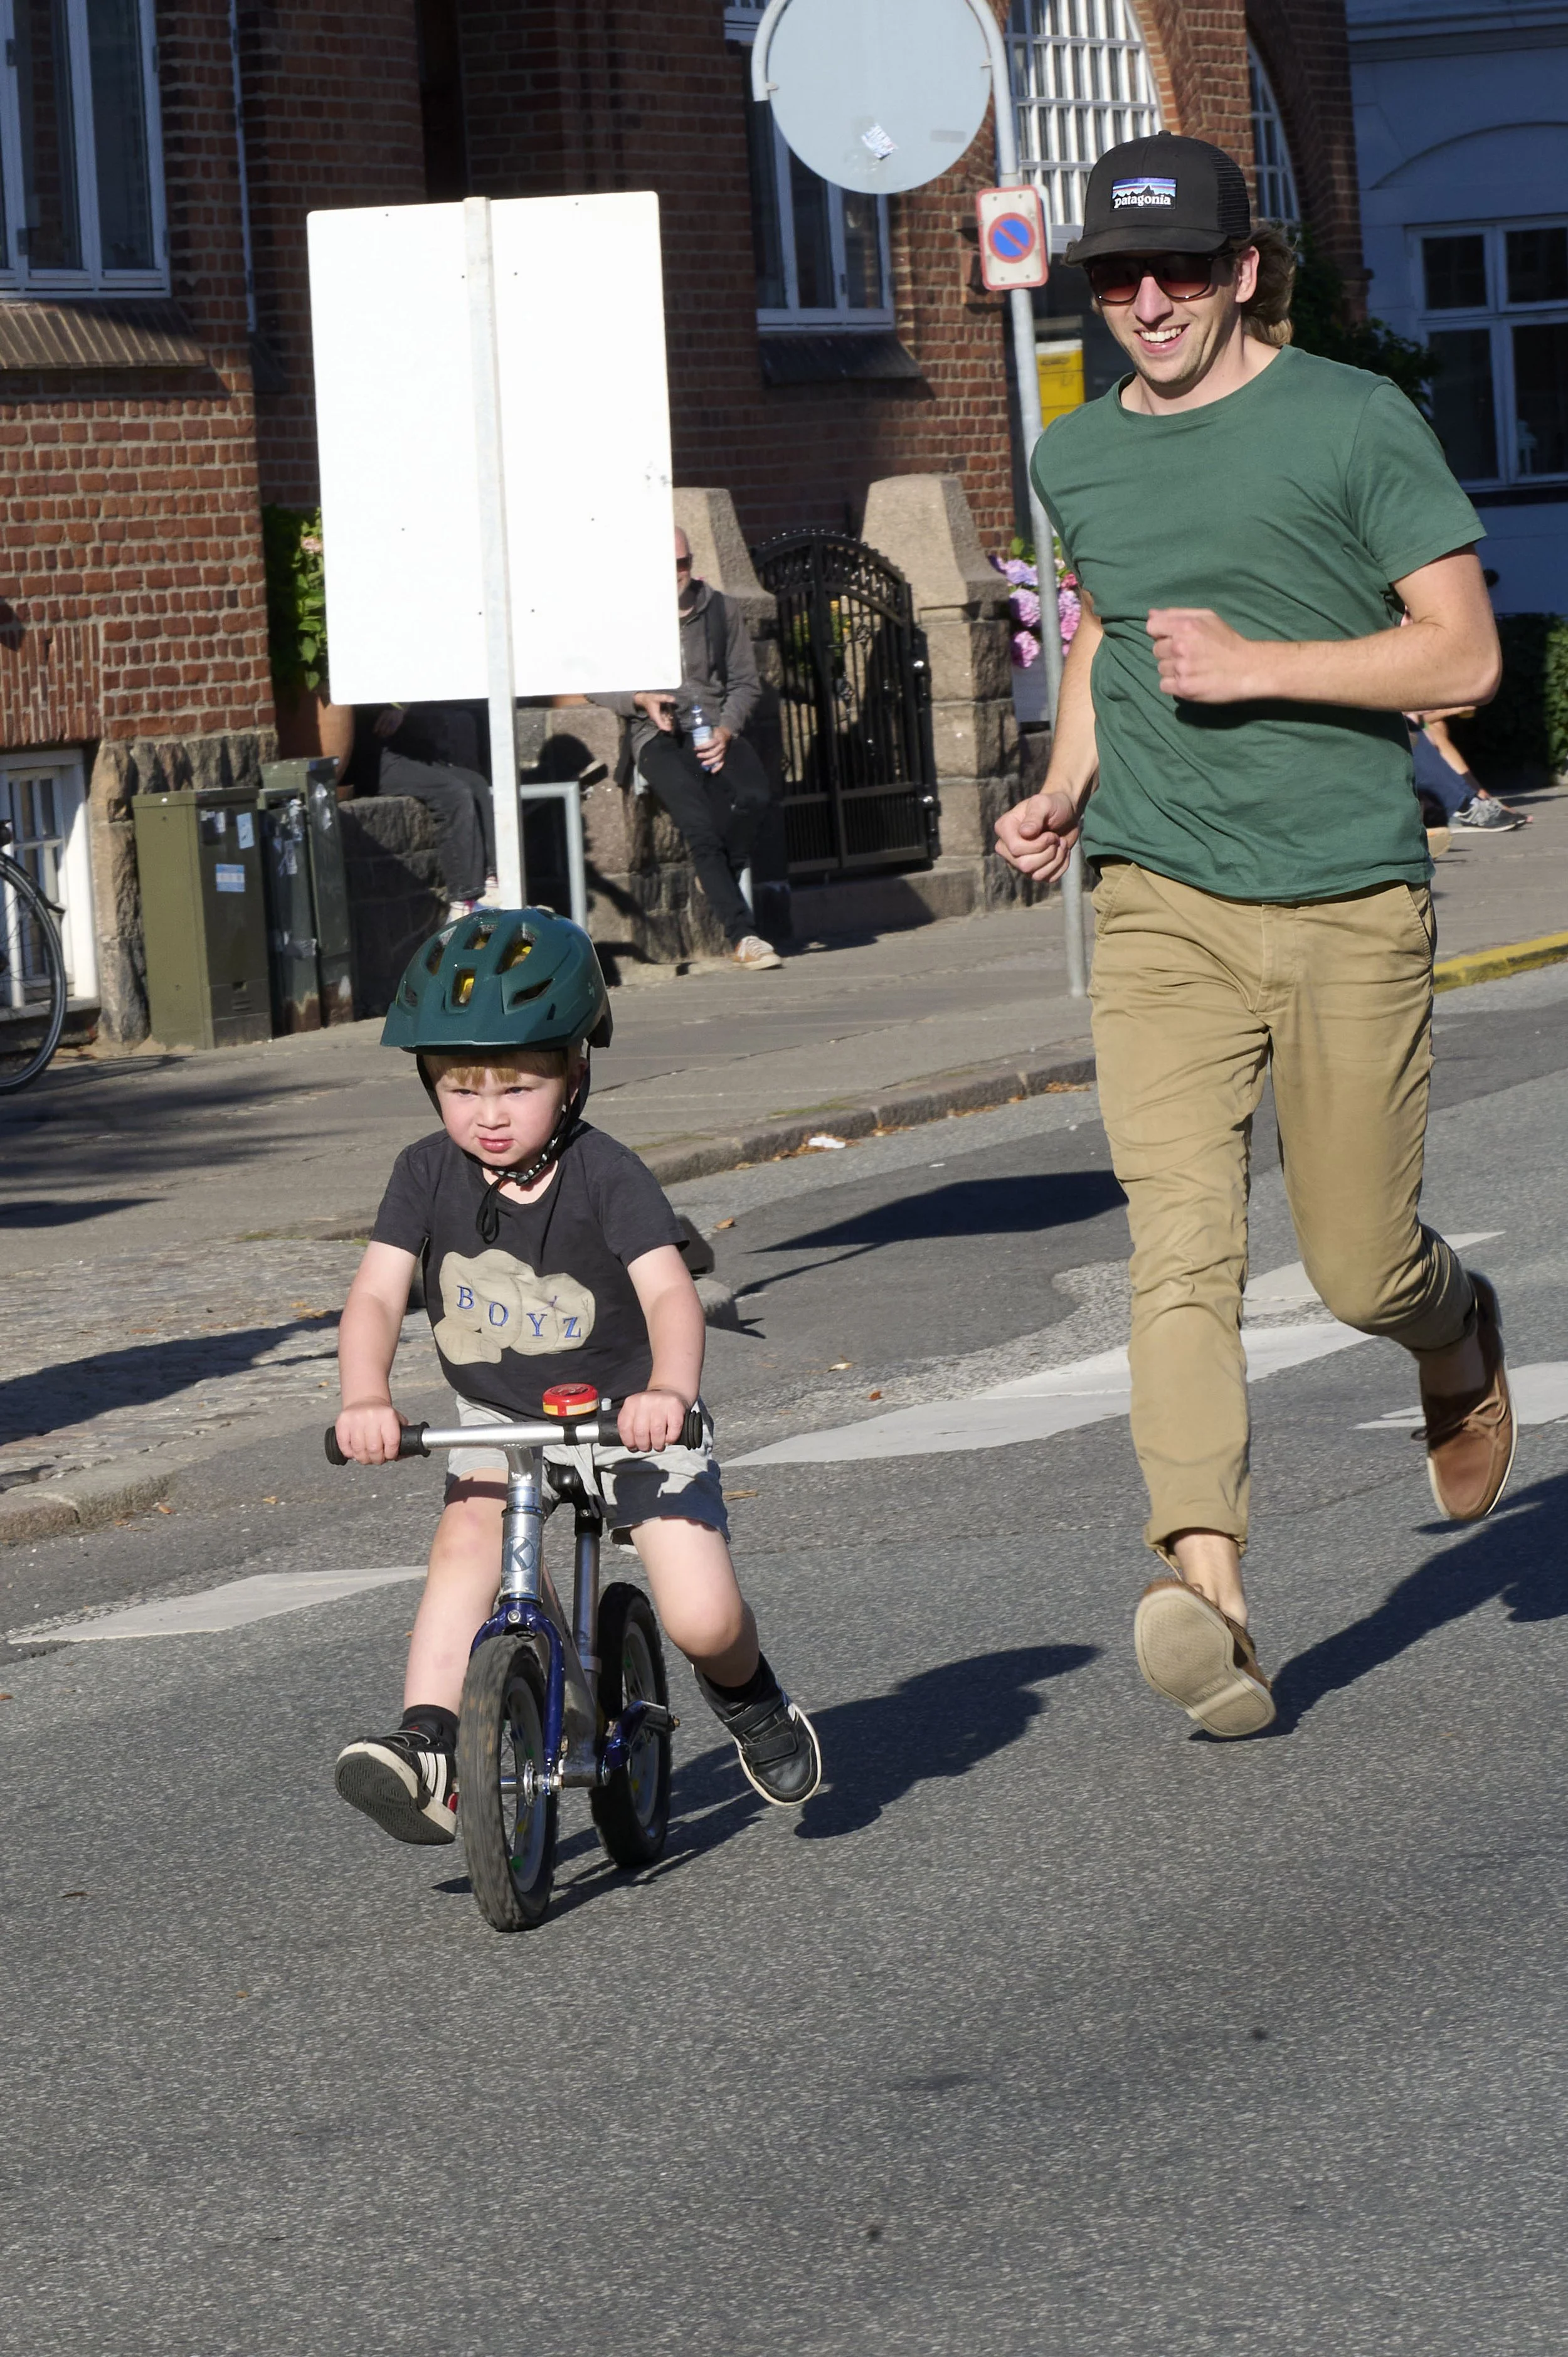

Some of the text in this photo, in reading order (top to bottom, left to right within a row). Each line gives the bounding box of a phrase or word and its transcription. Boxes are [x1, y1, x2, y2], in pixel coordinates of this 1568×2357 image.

[1114, 194, 1171, 209] patagonia
[457, 1285, 581, 1338] BOYZ
[506, 1538, 531, 1571] K
